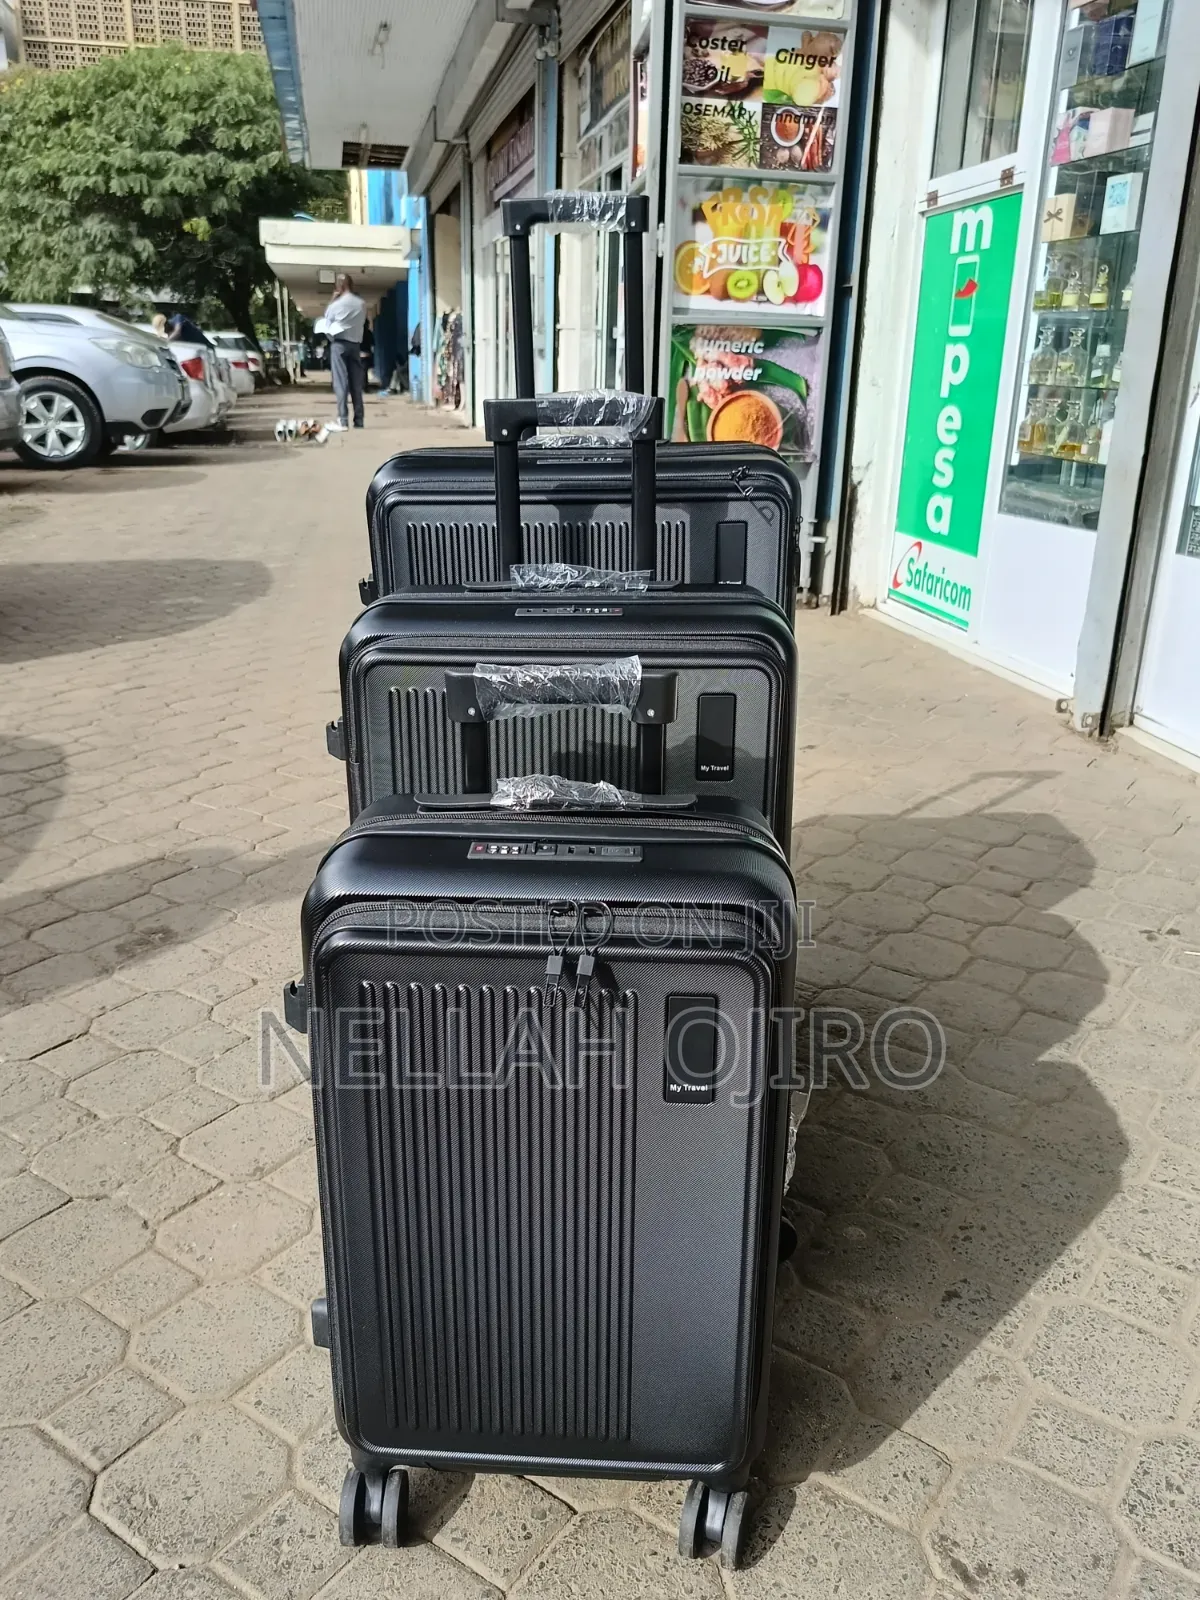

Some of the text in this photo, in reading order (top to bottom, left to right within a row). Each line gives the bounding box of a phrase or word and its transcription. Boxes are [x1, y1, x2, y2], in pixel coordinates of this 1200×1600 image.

[775, 47, 836, 68] Ginger
[705, 65, 731, 84] Oil
[682, 101, 756, 122] OSEMARY
[716, 243, 772, 264] JUICE
[905, 557, 972, 611] Safaricom
[670, 1084, 708, 1093] My Travel
